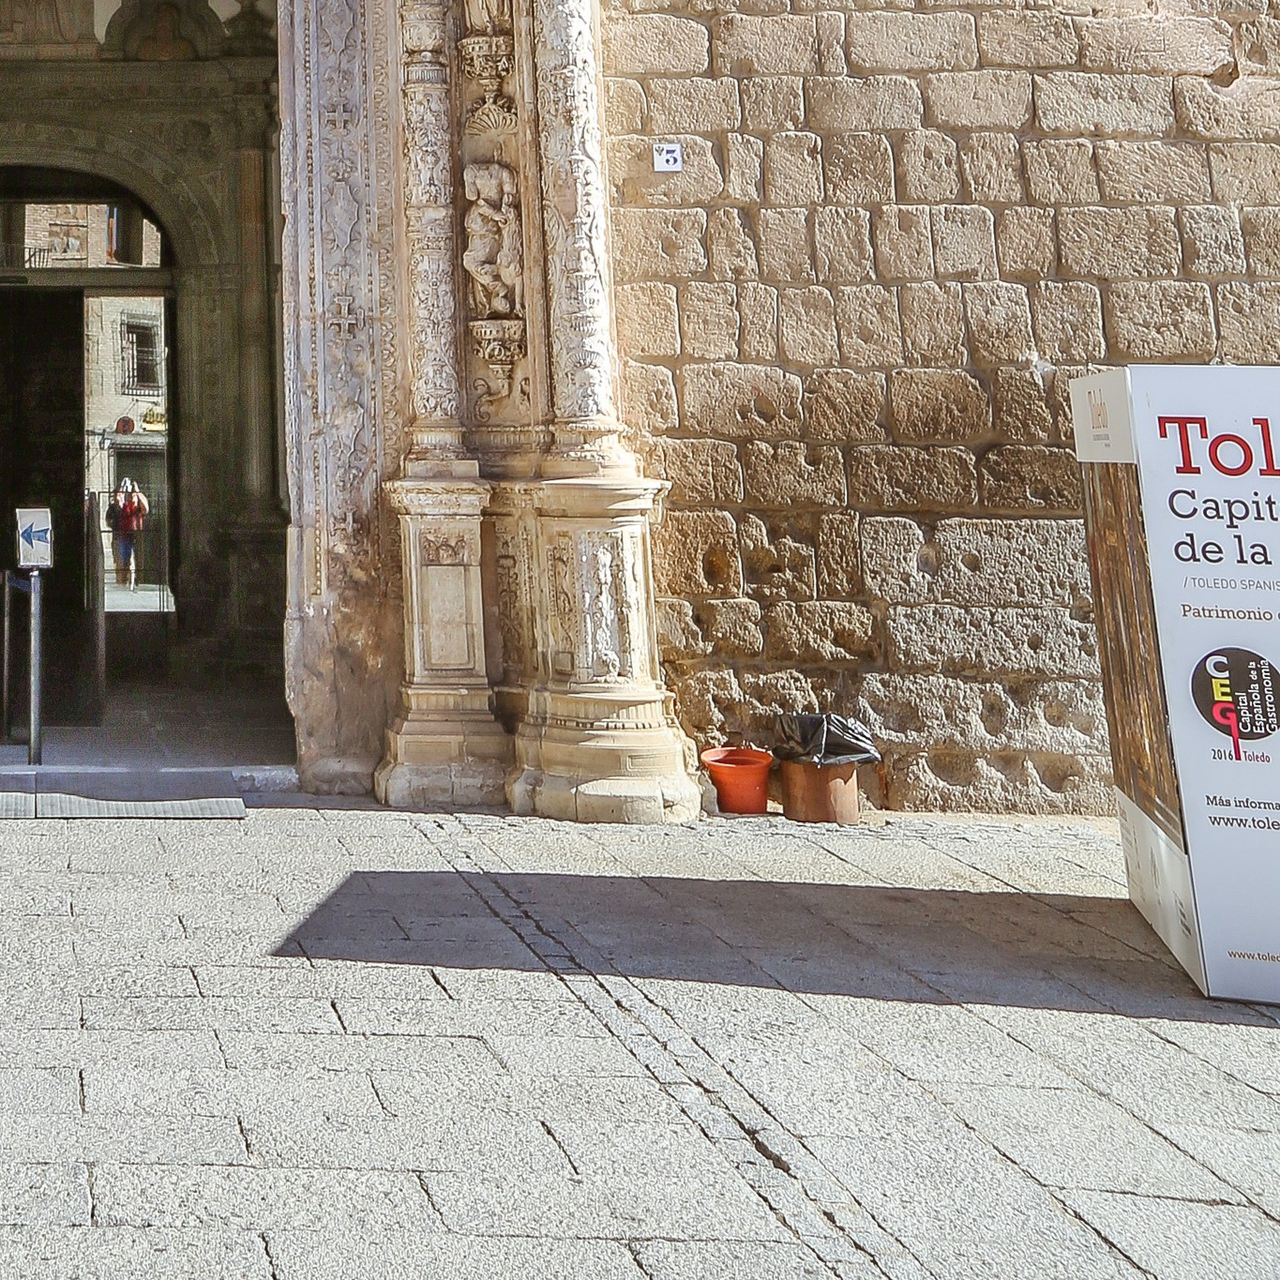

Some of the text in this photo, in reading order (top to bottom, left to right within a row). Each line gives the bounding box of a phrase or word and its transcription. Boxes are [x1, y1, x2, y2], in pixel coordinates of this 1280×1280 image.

[1157, 415, 1280, 478] Tol
[1168, 489, 1279, 529] Capit
[1174, 532, 1273, 565] de la
[1190, 577, 1237, 590] TOLEDO
[1180, 604, 1273, 621] Patrimonio
[1235, 692, 1253, 732] Capital
[1248, 661, 1267, 733] Española de la
[1257, 659, 1278, 733] Gastronomía
[1211, 748, 1271, 763] 2016 Toledo
[1205, 794, 1280, 810] Más informa
